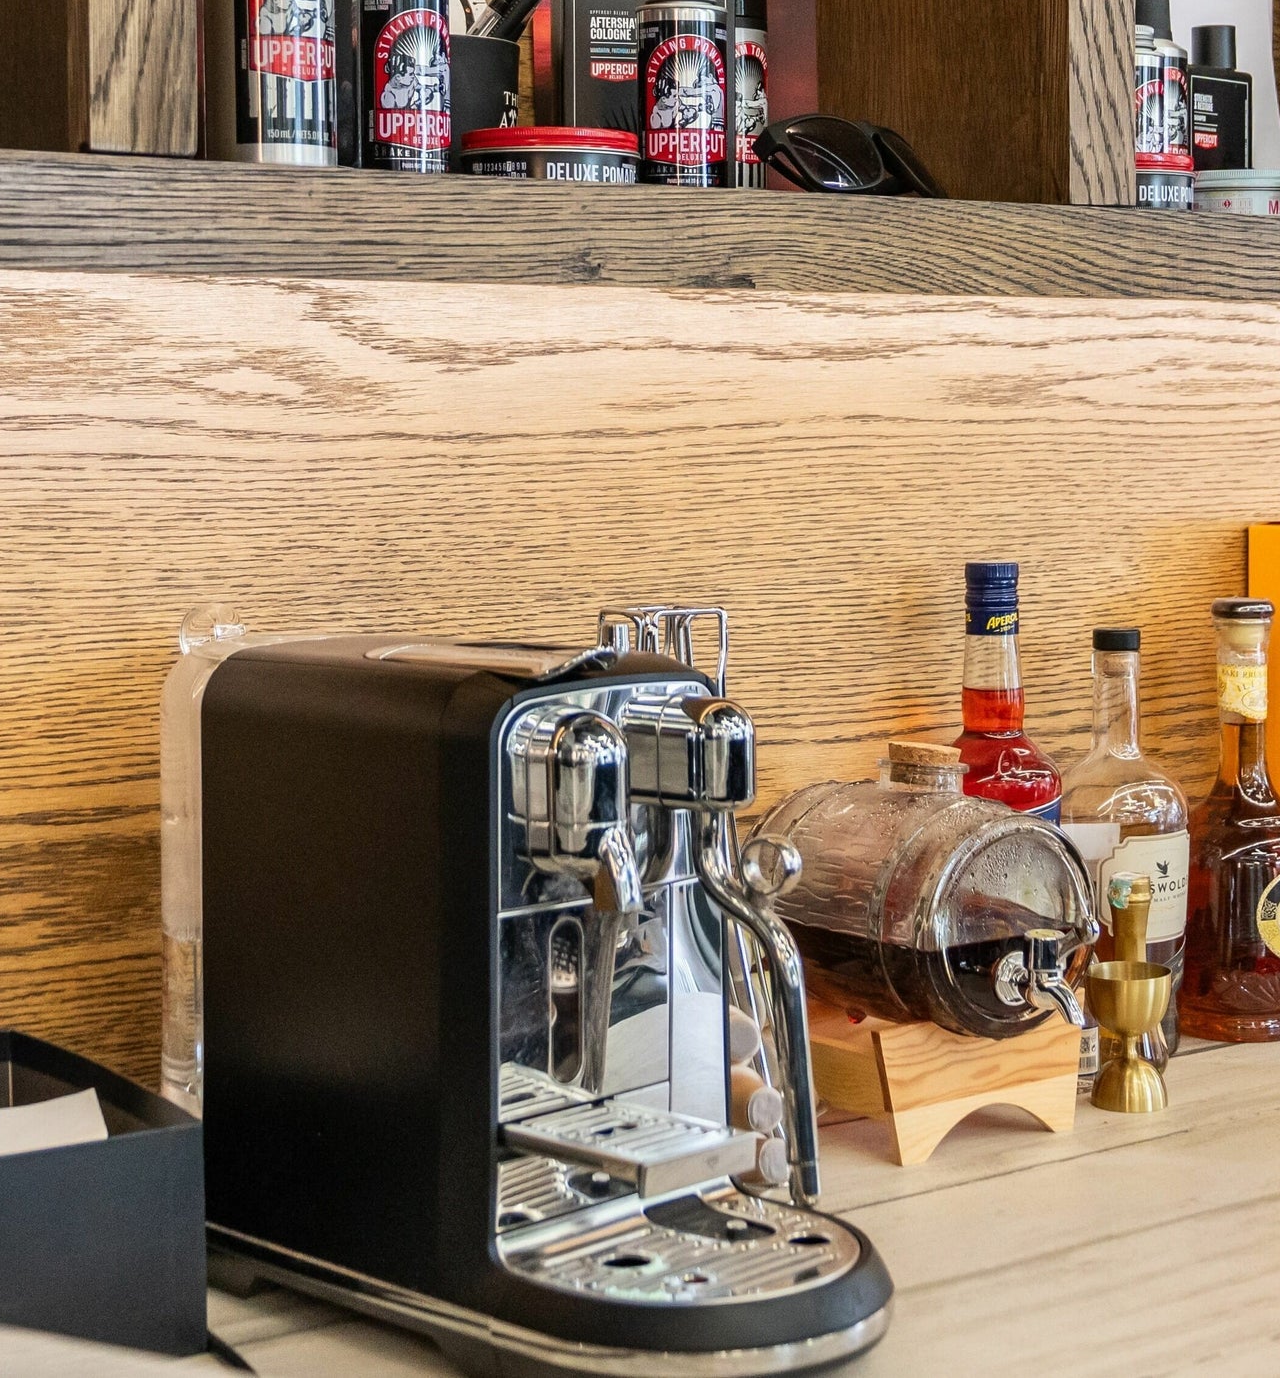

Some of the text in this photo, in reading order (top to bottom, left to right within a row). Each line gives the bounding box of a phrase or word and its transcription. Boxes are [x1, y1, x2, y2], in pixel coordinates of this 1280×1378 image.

[377, 11, 424, 59] STYLING
[590, 28, 632, 41] COLOGNE
[647, 38, 725, 84] STYLING POWDER
[751, 46, 768, 70] TONIC
[267, 129, 279, 139] 150
[1194, 133, 1218, 147] UPPERCUT
[649, 132, 725, 158] UPPERCUT
[677, 153, 705, 161] DELUXE
[546, 162, 600, 182] DELUXE
[1138, 185, 1180, 202] DELUXE
[986, 612, 1018, 630] APEROL
